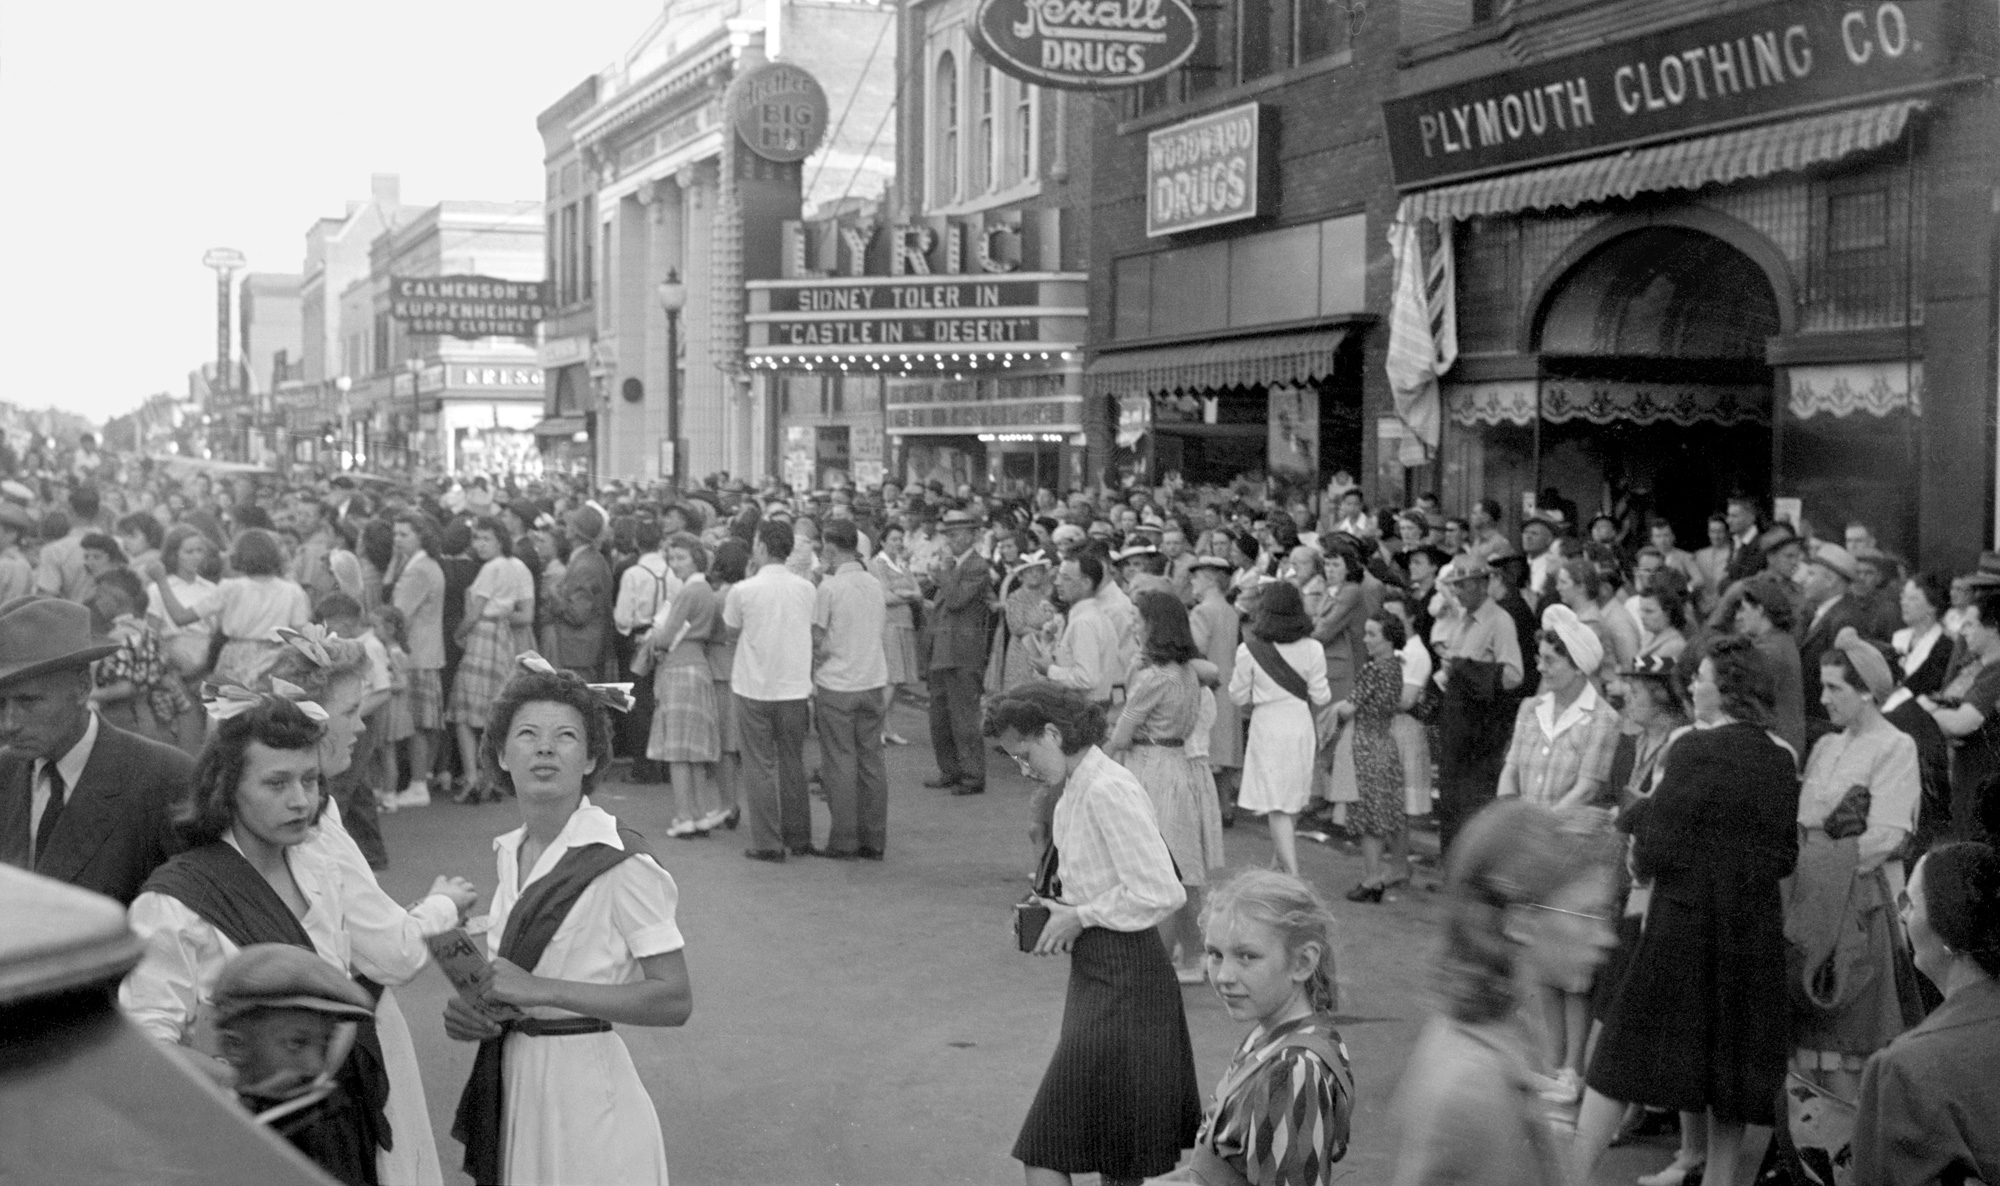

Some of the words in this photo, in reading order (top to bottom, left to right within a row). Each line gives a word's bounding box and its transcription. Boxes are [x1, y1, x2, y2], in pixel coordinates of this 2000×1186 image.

[1042, 39, 1146, 75] DRUGS
[1420, 77, 1595, 158] PLYMOUTH
[1613, 25, 1813, 115] CLOTHING
[1841, 3, 1924, 65] CO.
[762, 103, 812, 126] BIG
[761, 126, 810, 148] HIT
[1150, 117, 1252, 172] WOODWARD
[1156, 156, 1247, 223] DRUGS
[792, 221, 1022, 278] LYRIC
[400, 281, 538, 300] CALMENSON'S
[798, 287, 874, 311] SIDNEY
[891, 285, 960, 309] TOLER
[976, 284, 999, 306] IN
[395, 301, 543, 319] KUPPENHEIMER
[459, 320, 525, 333] CLOTHES
[780, 321, 873, 345] "CASTLE
[880, 320, 903, 343] IN
[934, 318, 1031, 342] DESERT"
